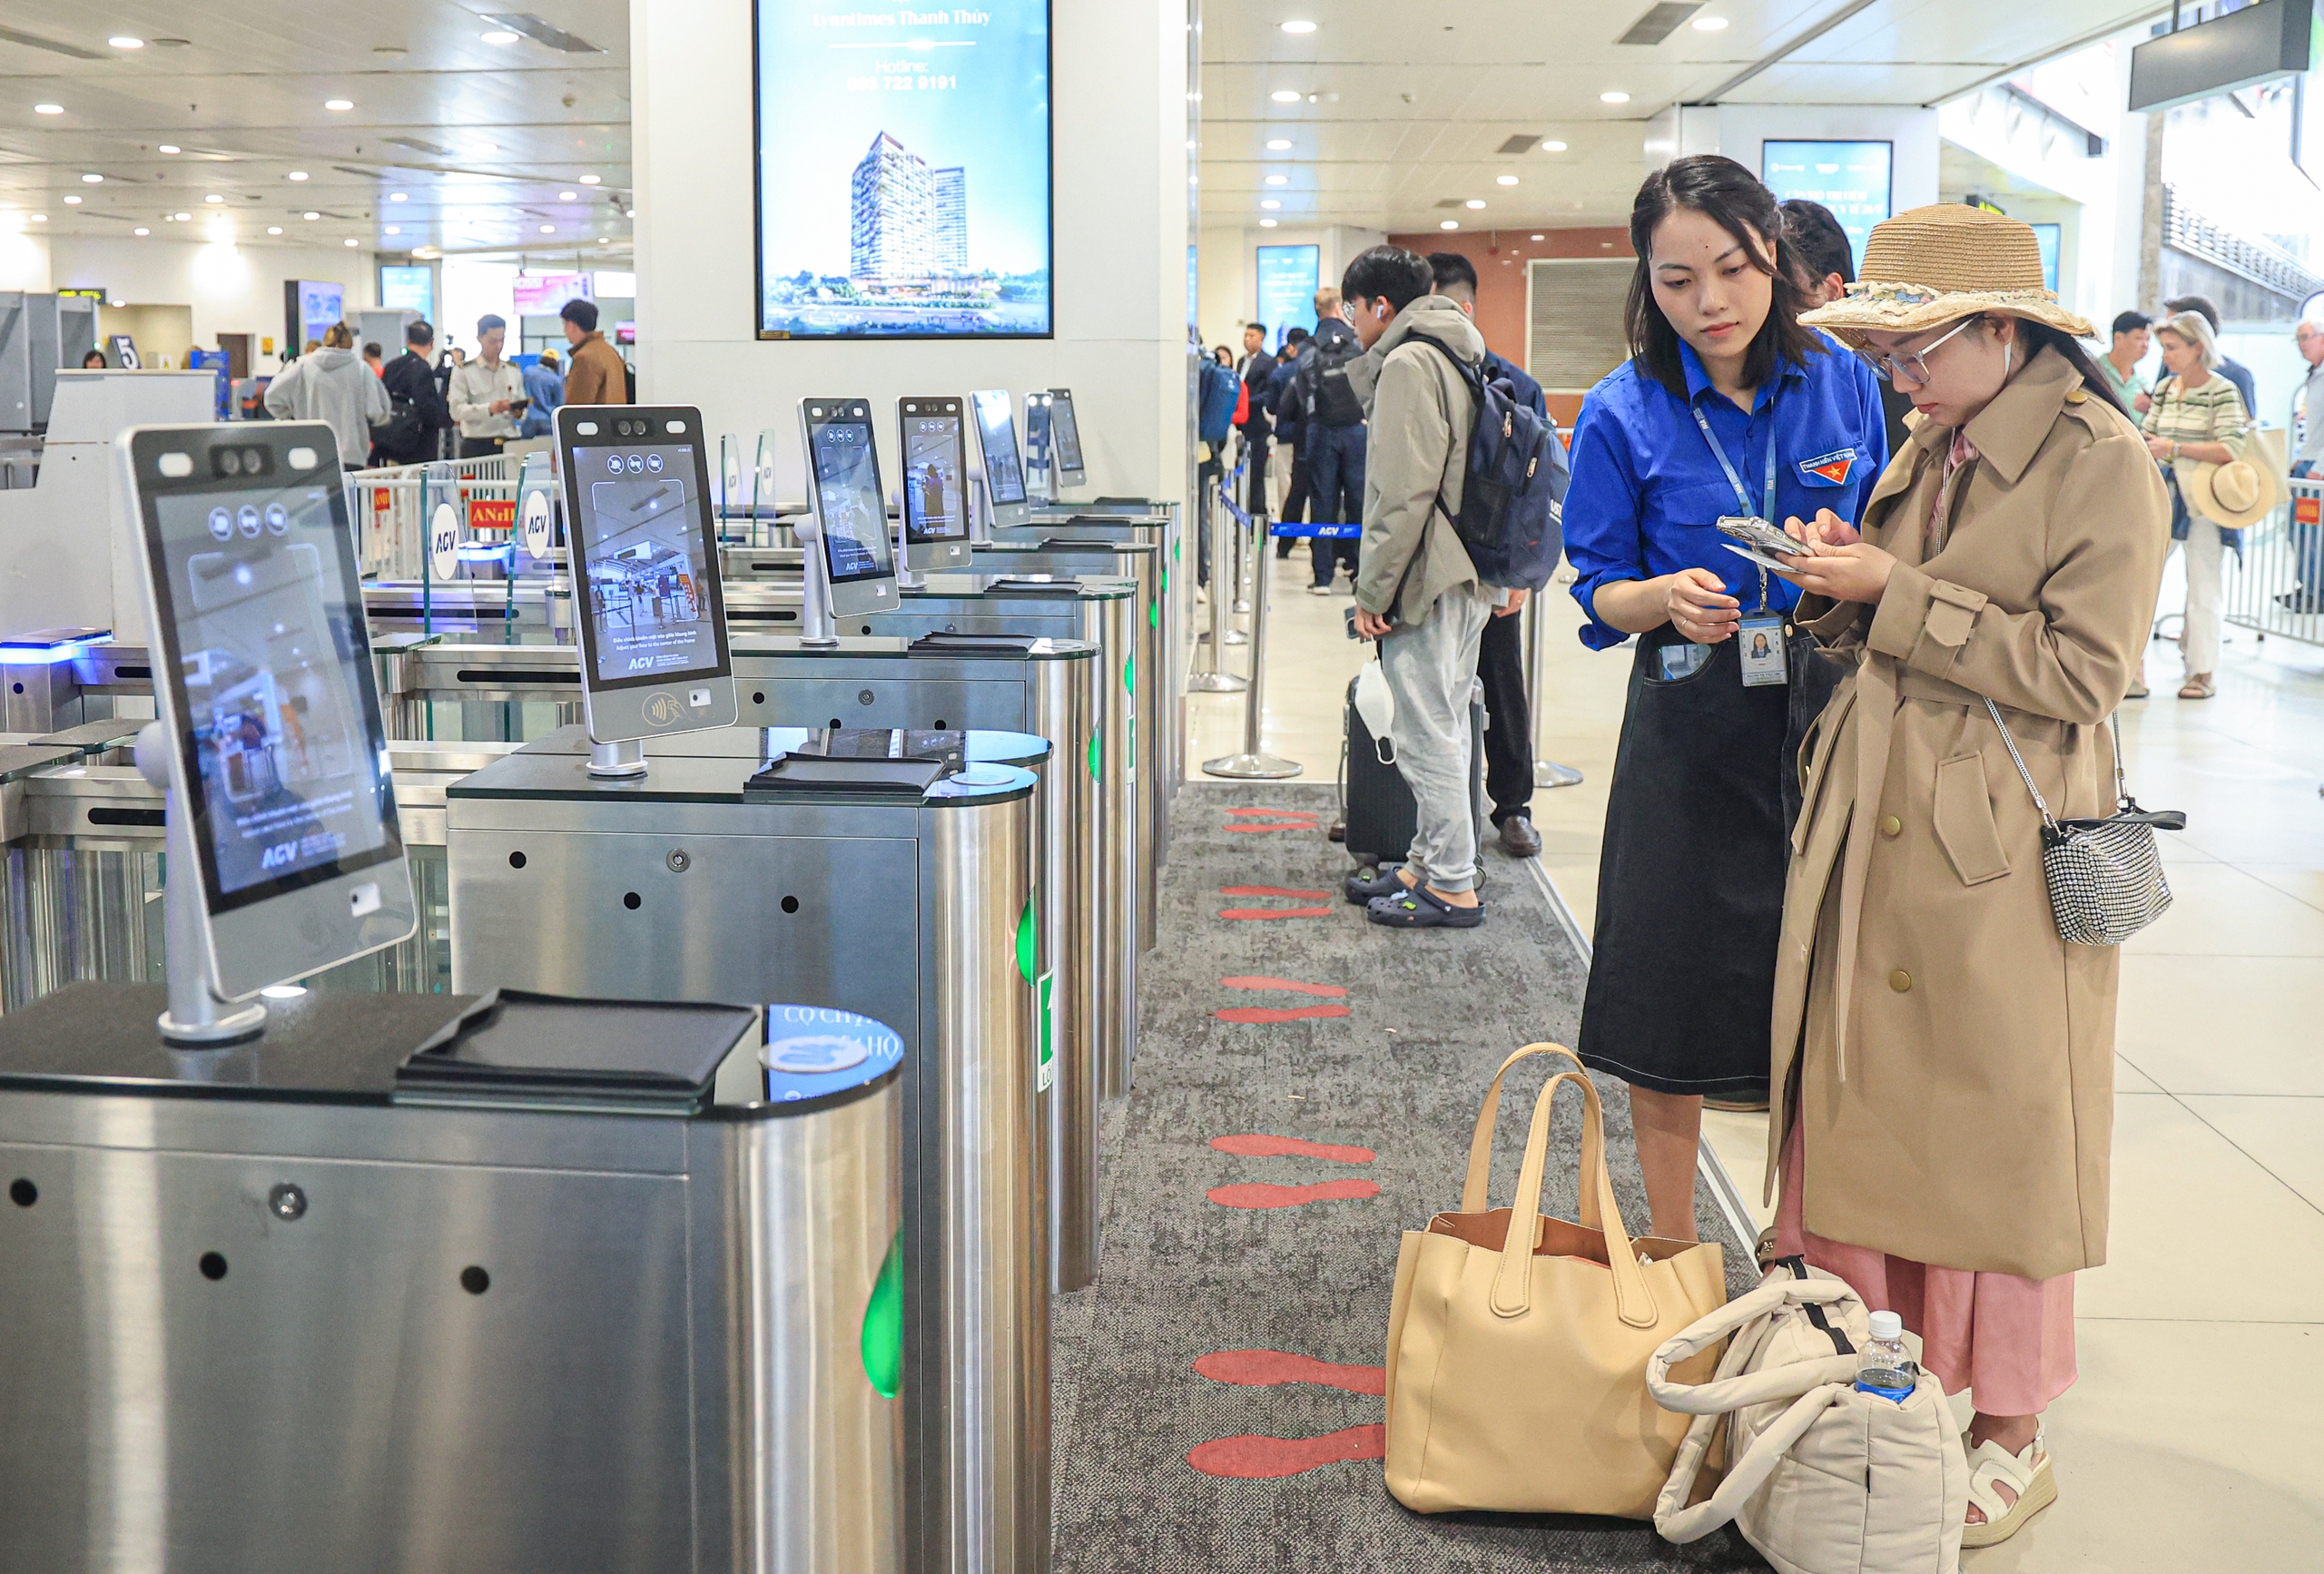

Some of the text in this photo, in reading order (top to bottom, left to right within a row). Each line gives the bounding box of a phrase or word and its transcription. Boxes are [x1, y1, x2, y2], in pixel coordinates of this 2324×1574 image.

[813, 12, 896, 29] Lynntimes
[899, 10, 949, 25] Thanh
[875, 59, 929, 74] Hotline:
[917, 74, 956, 90] 9191
[115, 337, 138, 369] 5
[527, 515, 547, 535] ACV
[1318, 526, 1340, 536] ACV
[436, 530, 457, 554] ACV
[628, 655, 654, 670] ACV
[261, 841, 298, 870] ACV
